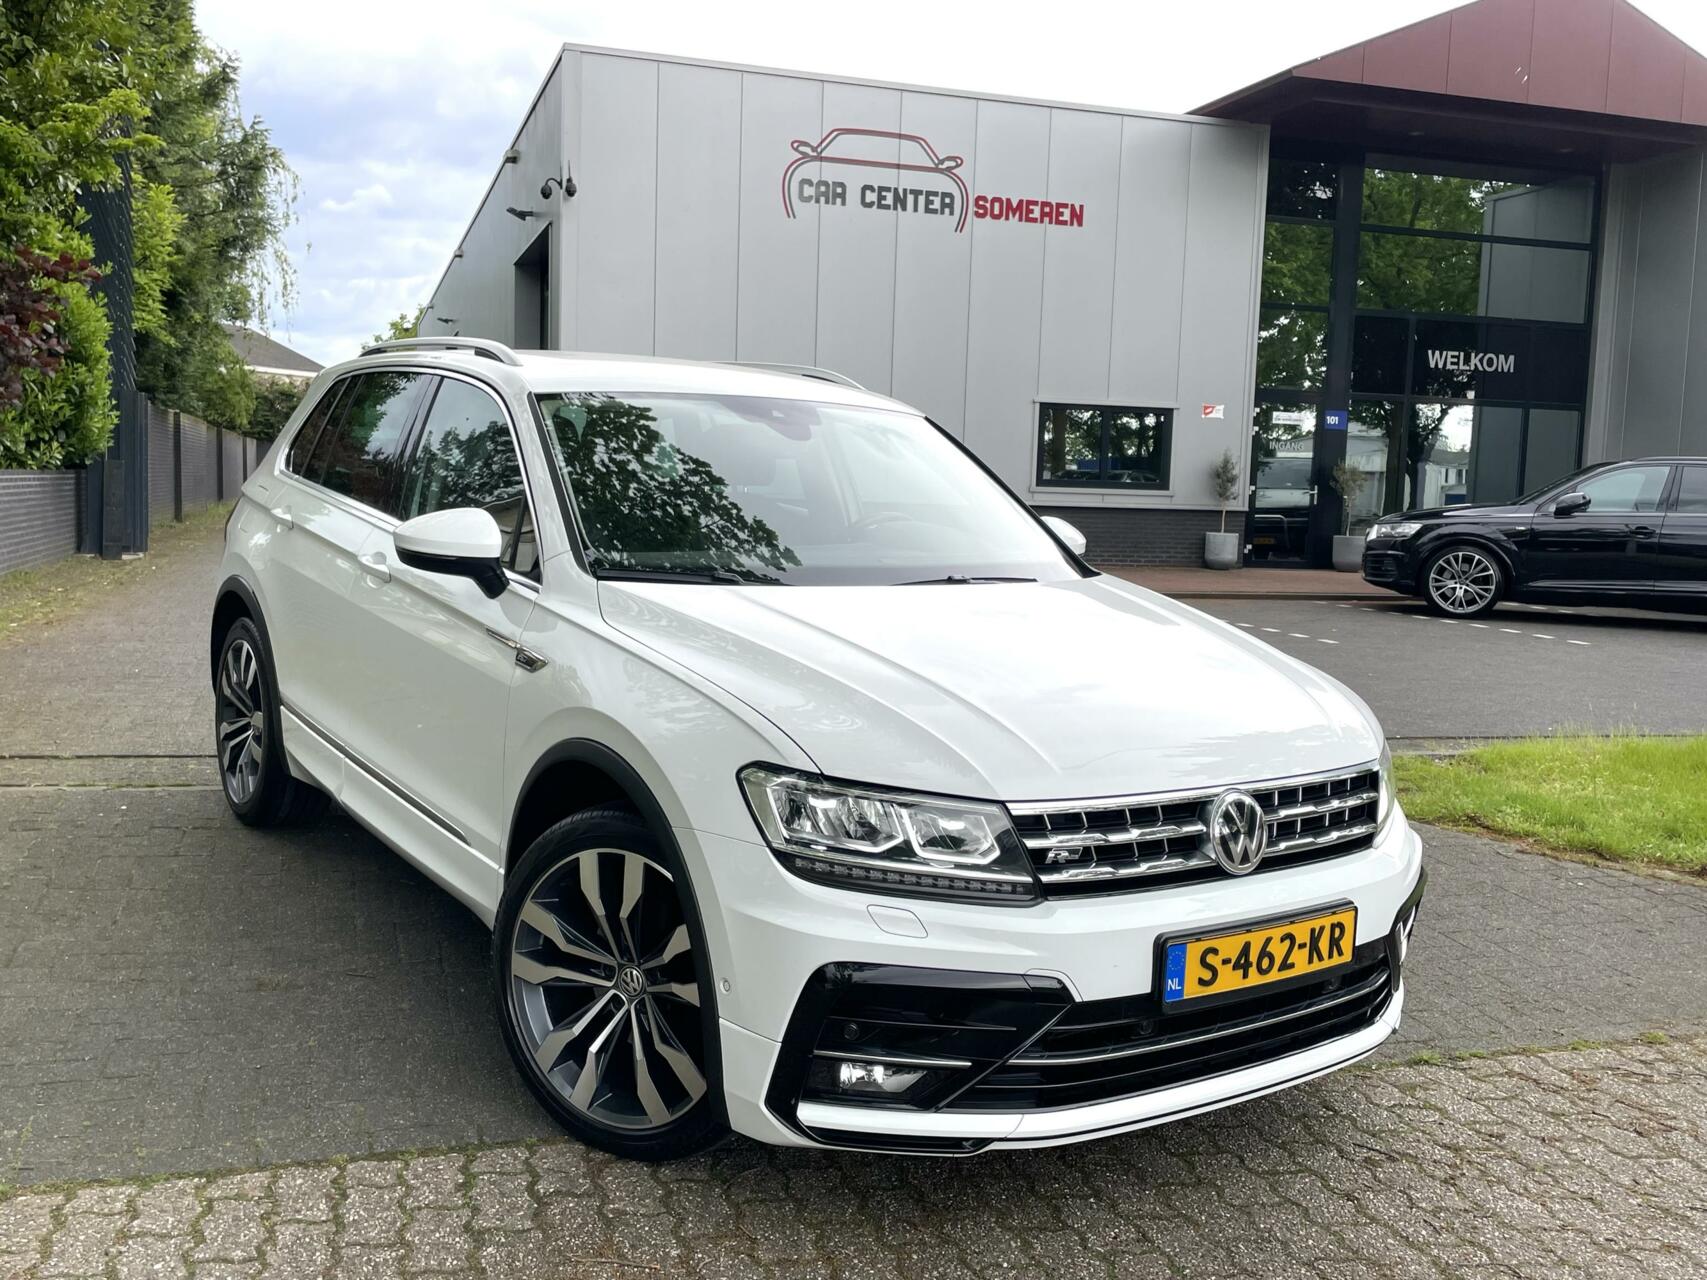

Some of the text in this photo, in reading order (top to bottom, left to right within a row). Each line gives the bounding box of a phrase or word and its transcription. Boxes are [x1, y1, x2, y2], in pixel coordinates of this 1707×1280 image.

[798, 178, 1085, 227] CAR CENTER SOMEREN
[1427, 349, 1515, 373] WELKOM
[1326, 415, 1339, 425] 101
[1269, 440, 1305, 451] INGANG
[1197, 919, 1346, 987] S-462-KR
[1168, 979, 1182, 991] NL
